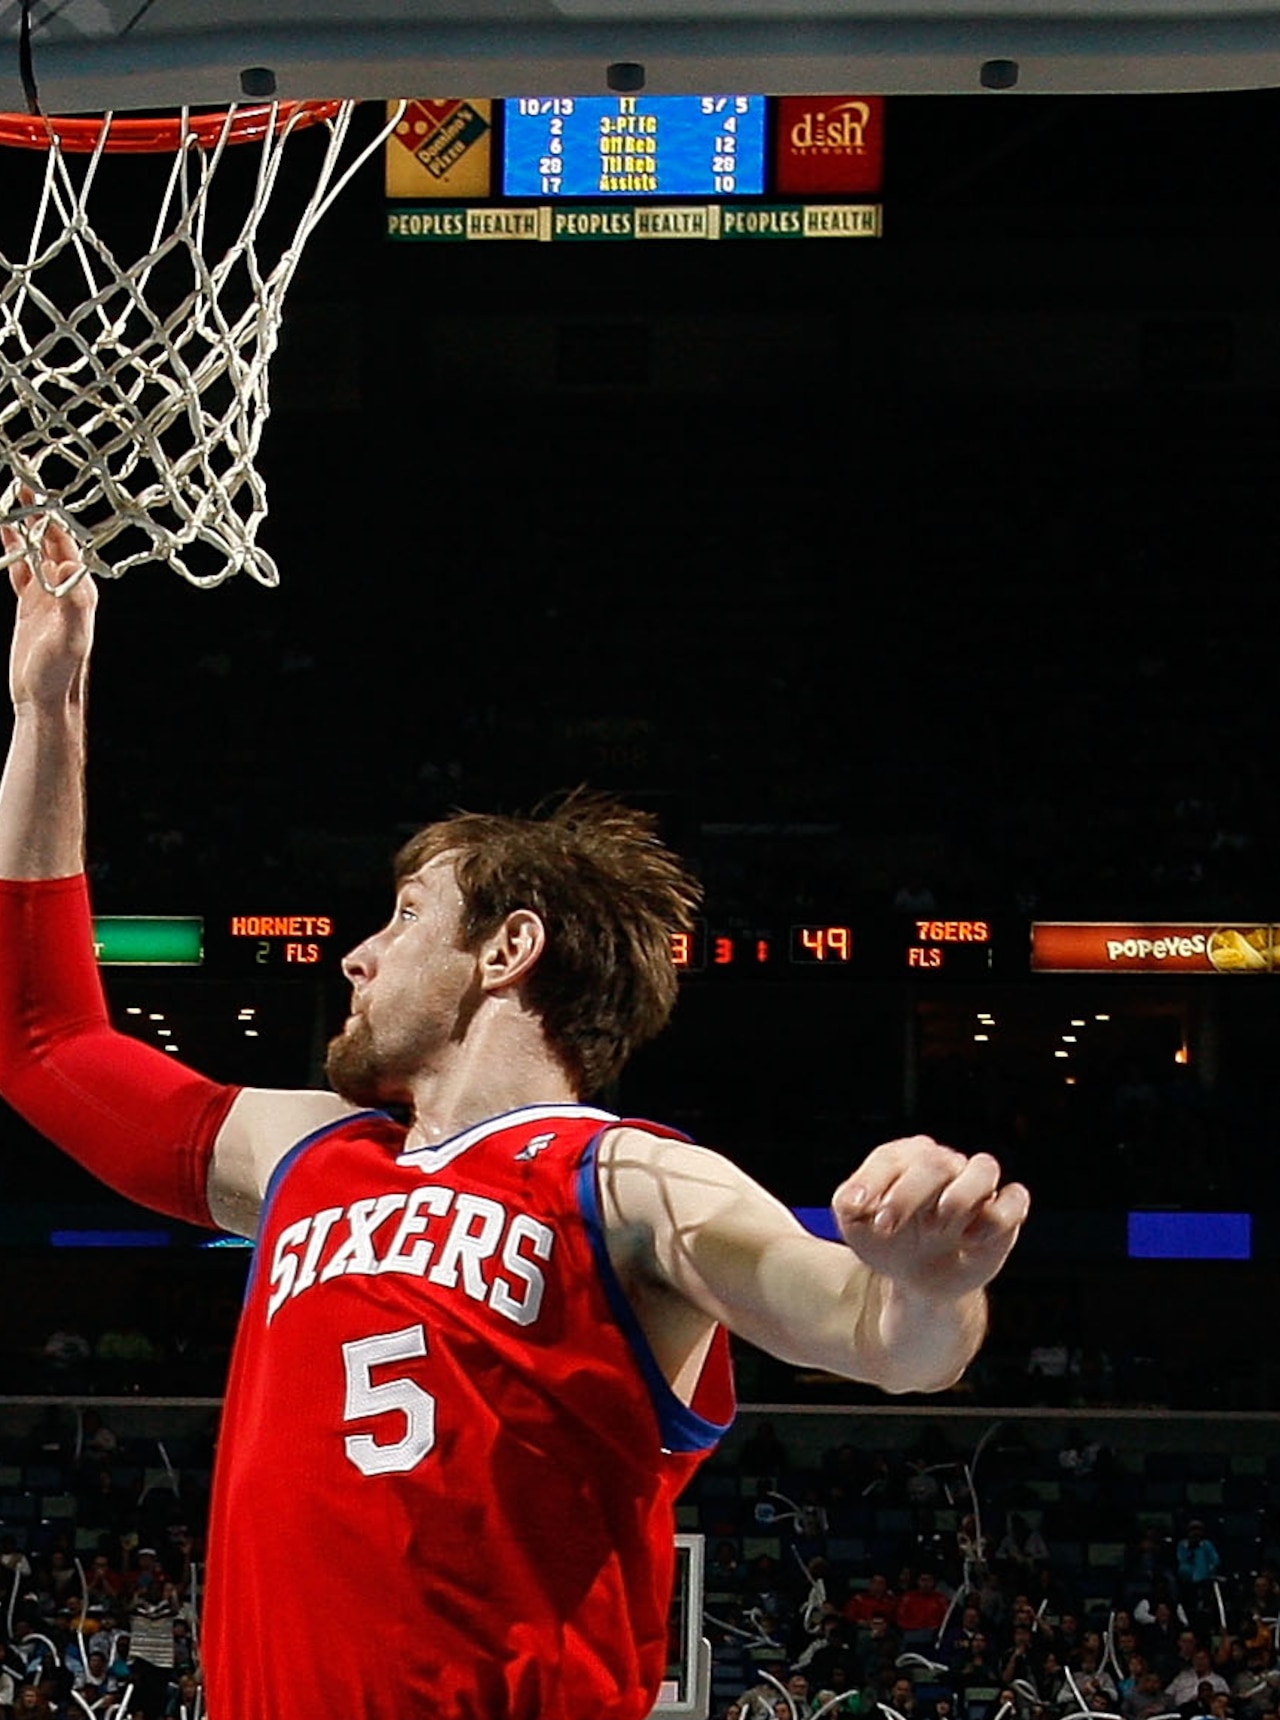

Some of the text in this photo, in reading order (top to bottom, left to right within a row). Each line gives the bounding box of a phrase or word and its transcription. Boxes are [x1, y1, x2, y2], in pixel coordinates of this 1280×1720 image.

[550, 119, 563, 135] 2
[723, 117, 737, 133] 4
[791, 109, 867, 147] dish
[550, 138, 563, 154] 6
[715, 137, 736, 153] 12
[542, 177, 563, 194] 17
[599, 174, 658, 192] Assists
[714, 176, 736, 192] 10
[388, 214, 535, 235] PEOPLES HEALTH
[555, 213, 703, 234] PEOPLES HEALTH
[724, 210, 875, 233] PEOPLES HEALTH
[232, 916, 331, 936] HORNETS
[915, 921, 988, 941] 76ERS
[255, 941, 320, 964] 2 FLS
[803, 928, 848, 961] 49
[908, 947, 942, 968] FLS
[266, 1185, 555, 1328] SIXERS
[341, 1323, 436, 1477] 5
